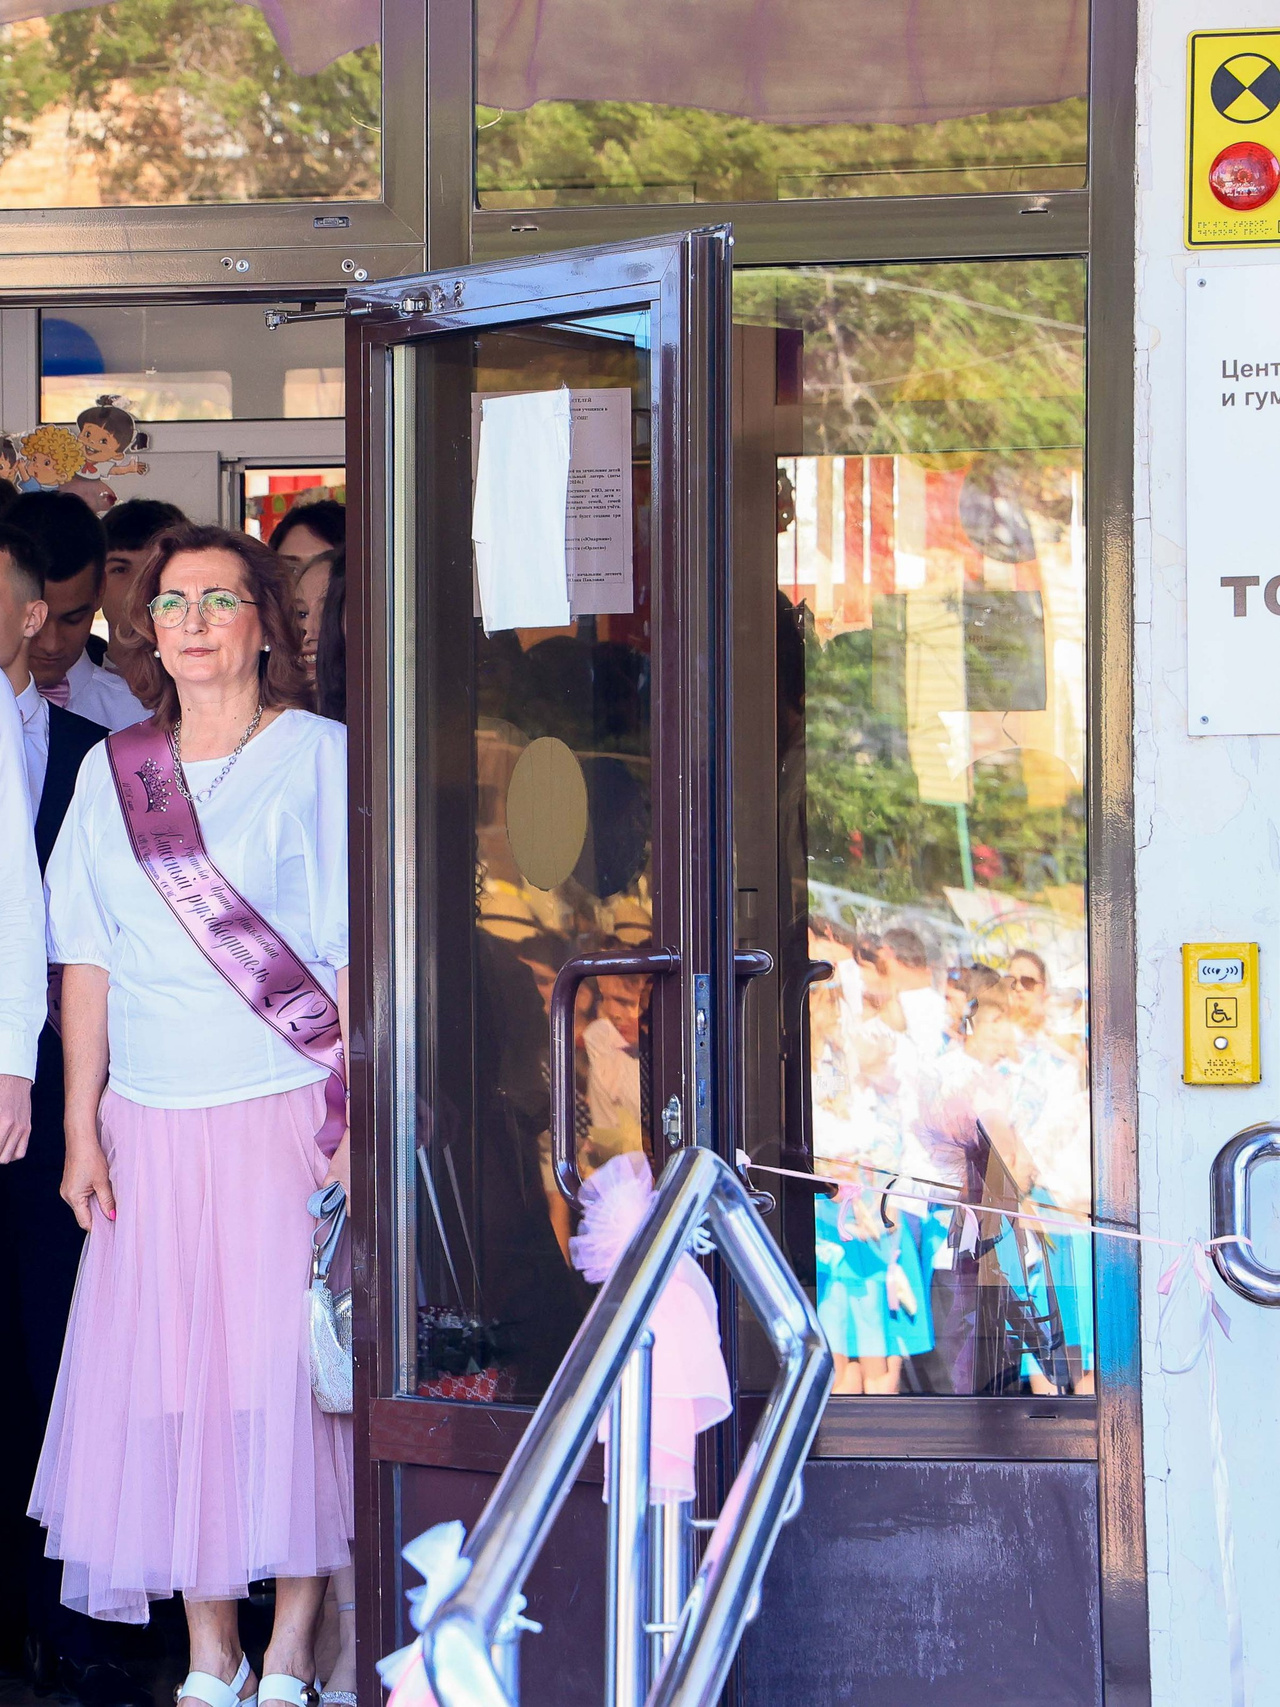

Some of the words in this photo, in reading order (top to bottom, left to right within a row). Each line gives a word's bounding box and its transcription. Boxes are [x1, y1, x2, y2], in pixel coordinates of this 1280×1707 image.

[1222, 359, 1280, 382] Цент
[1222, 392, 1235, 407] и
[150, 824, 198, 891] Классный
[176, 893, 271, 984] руководитель
[261, 974, 340, 1046] 2024
[231, 910, 280, 960] Николаевна
